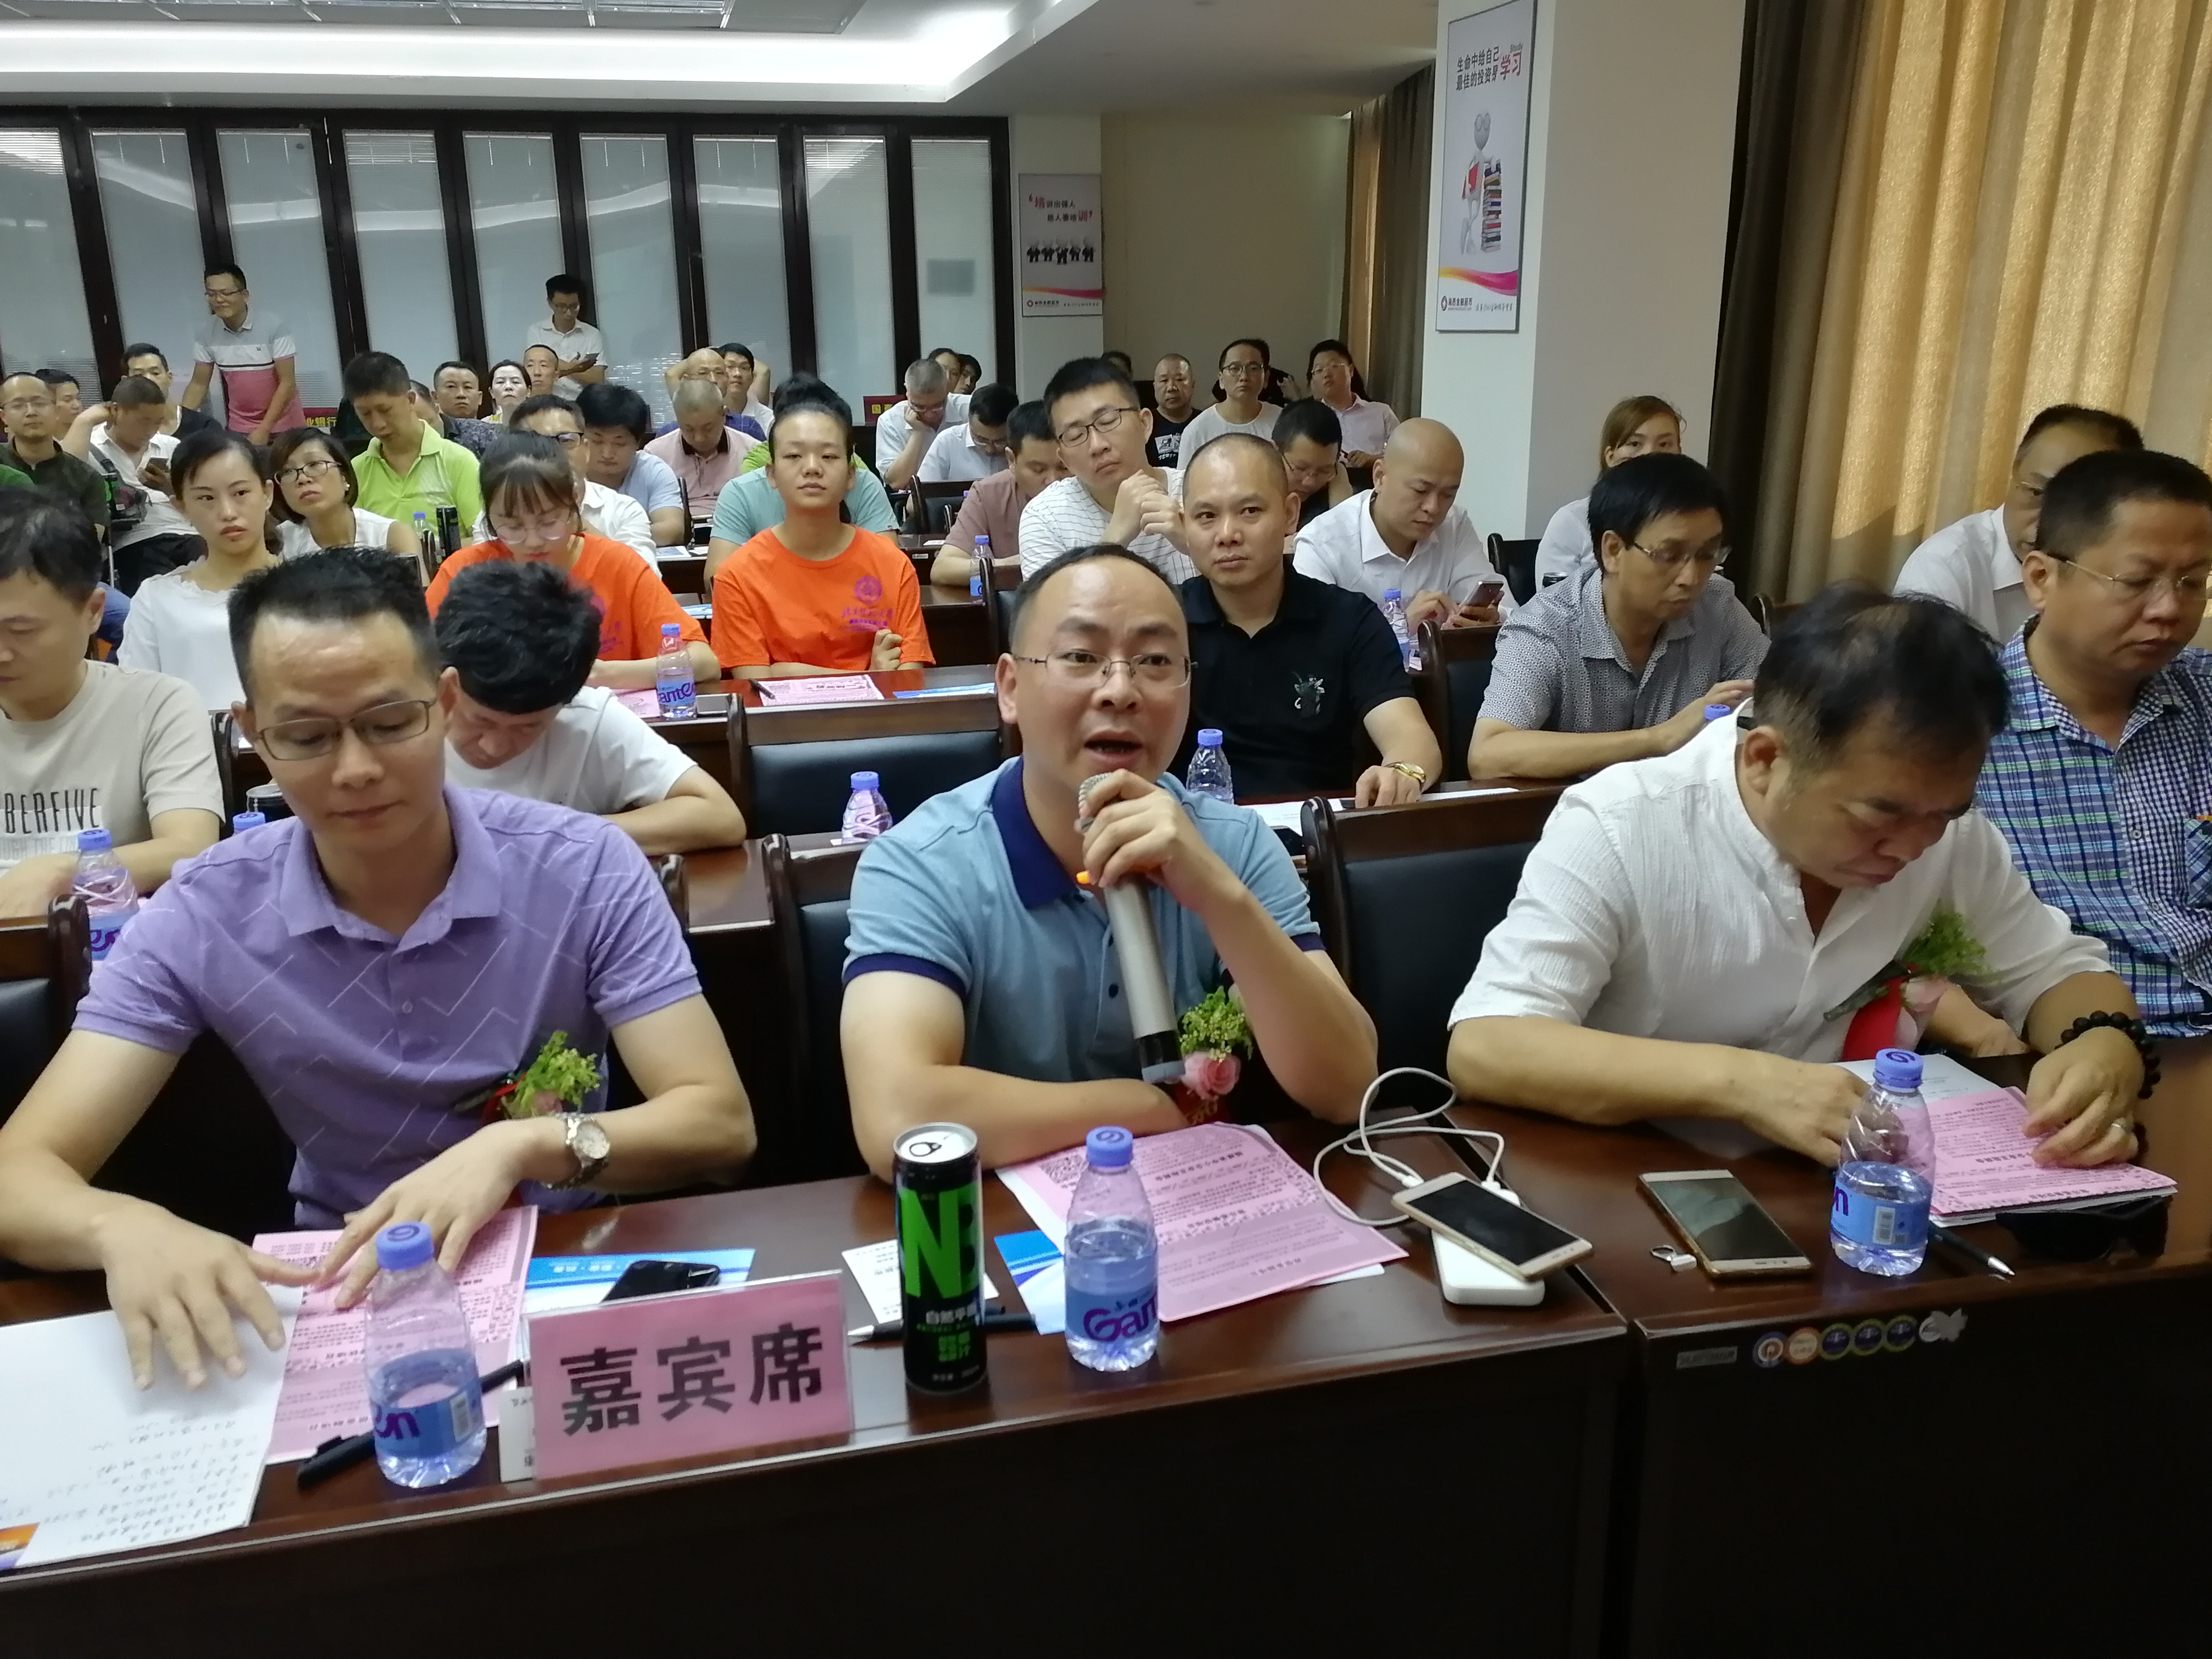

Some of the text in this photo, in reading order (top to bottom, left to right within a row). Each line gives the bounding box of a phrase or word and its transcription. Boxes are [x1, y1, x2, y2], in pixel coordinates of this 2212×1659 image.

[1457, 46, 1500, 73] 生命中给自己
[1500, 51, 1522, 81] 学习
[1456, 65, 1499, 91] 最佳的投资是
[560, 1322, 823, 1437] 嘉宾席
